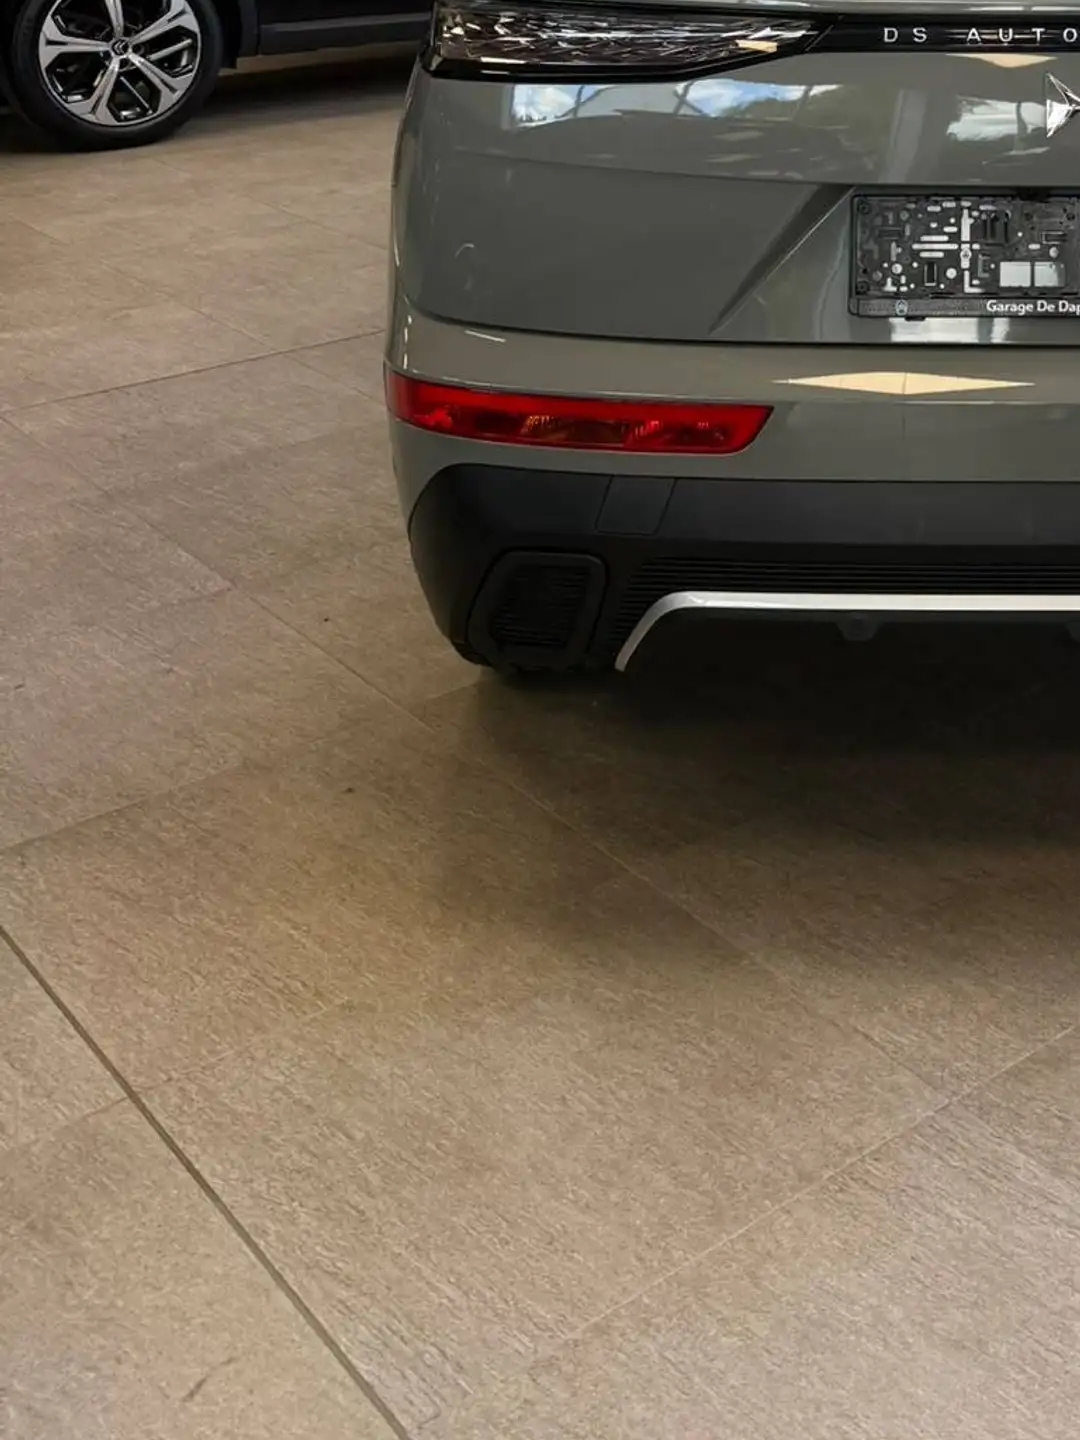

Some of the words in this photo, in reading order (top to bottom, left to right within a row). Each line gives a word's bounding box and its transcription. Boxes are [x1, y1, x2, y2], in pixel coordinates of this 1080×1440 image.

[884, 27, 928, 43] DS
[986, 300, 1034, 316] Garage
[1037, 301, 1055, 313] De
